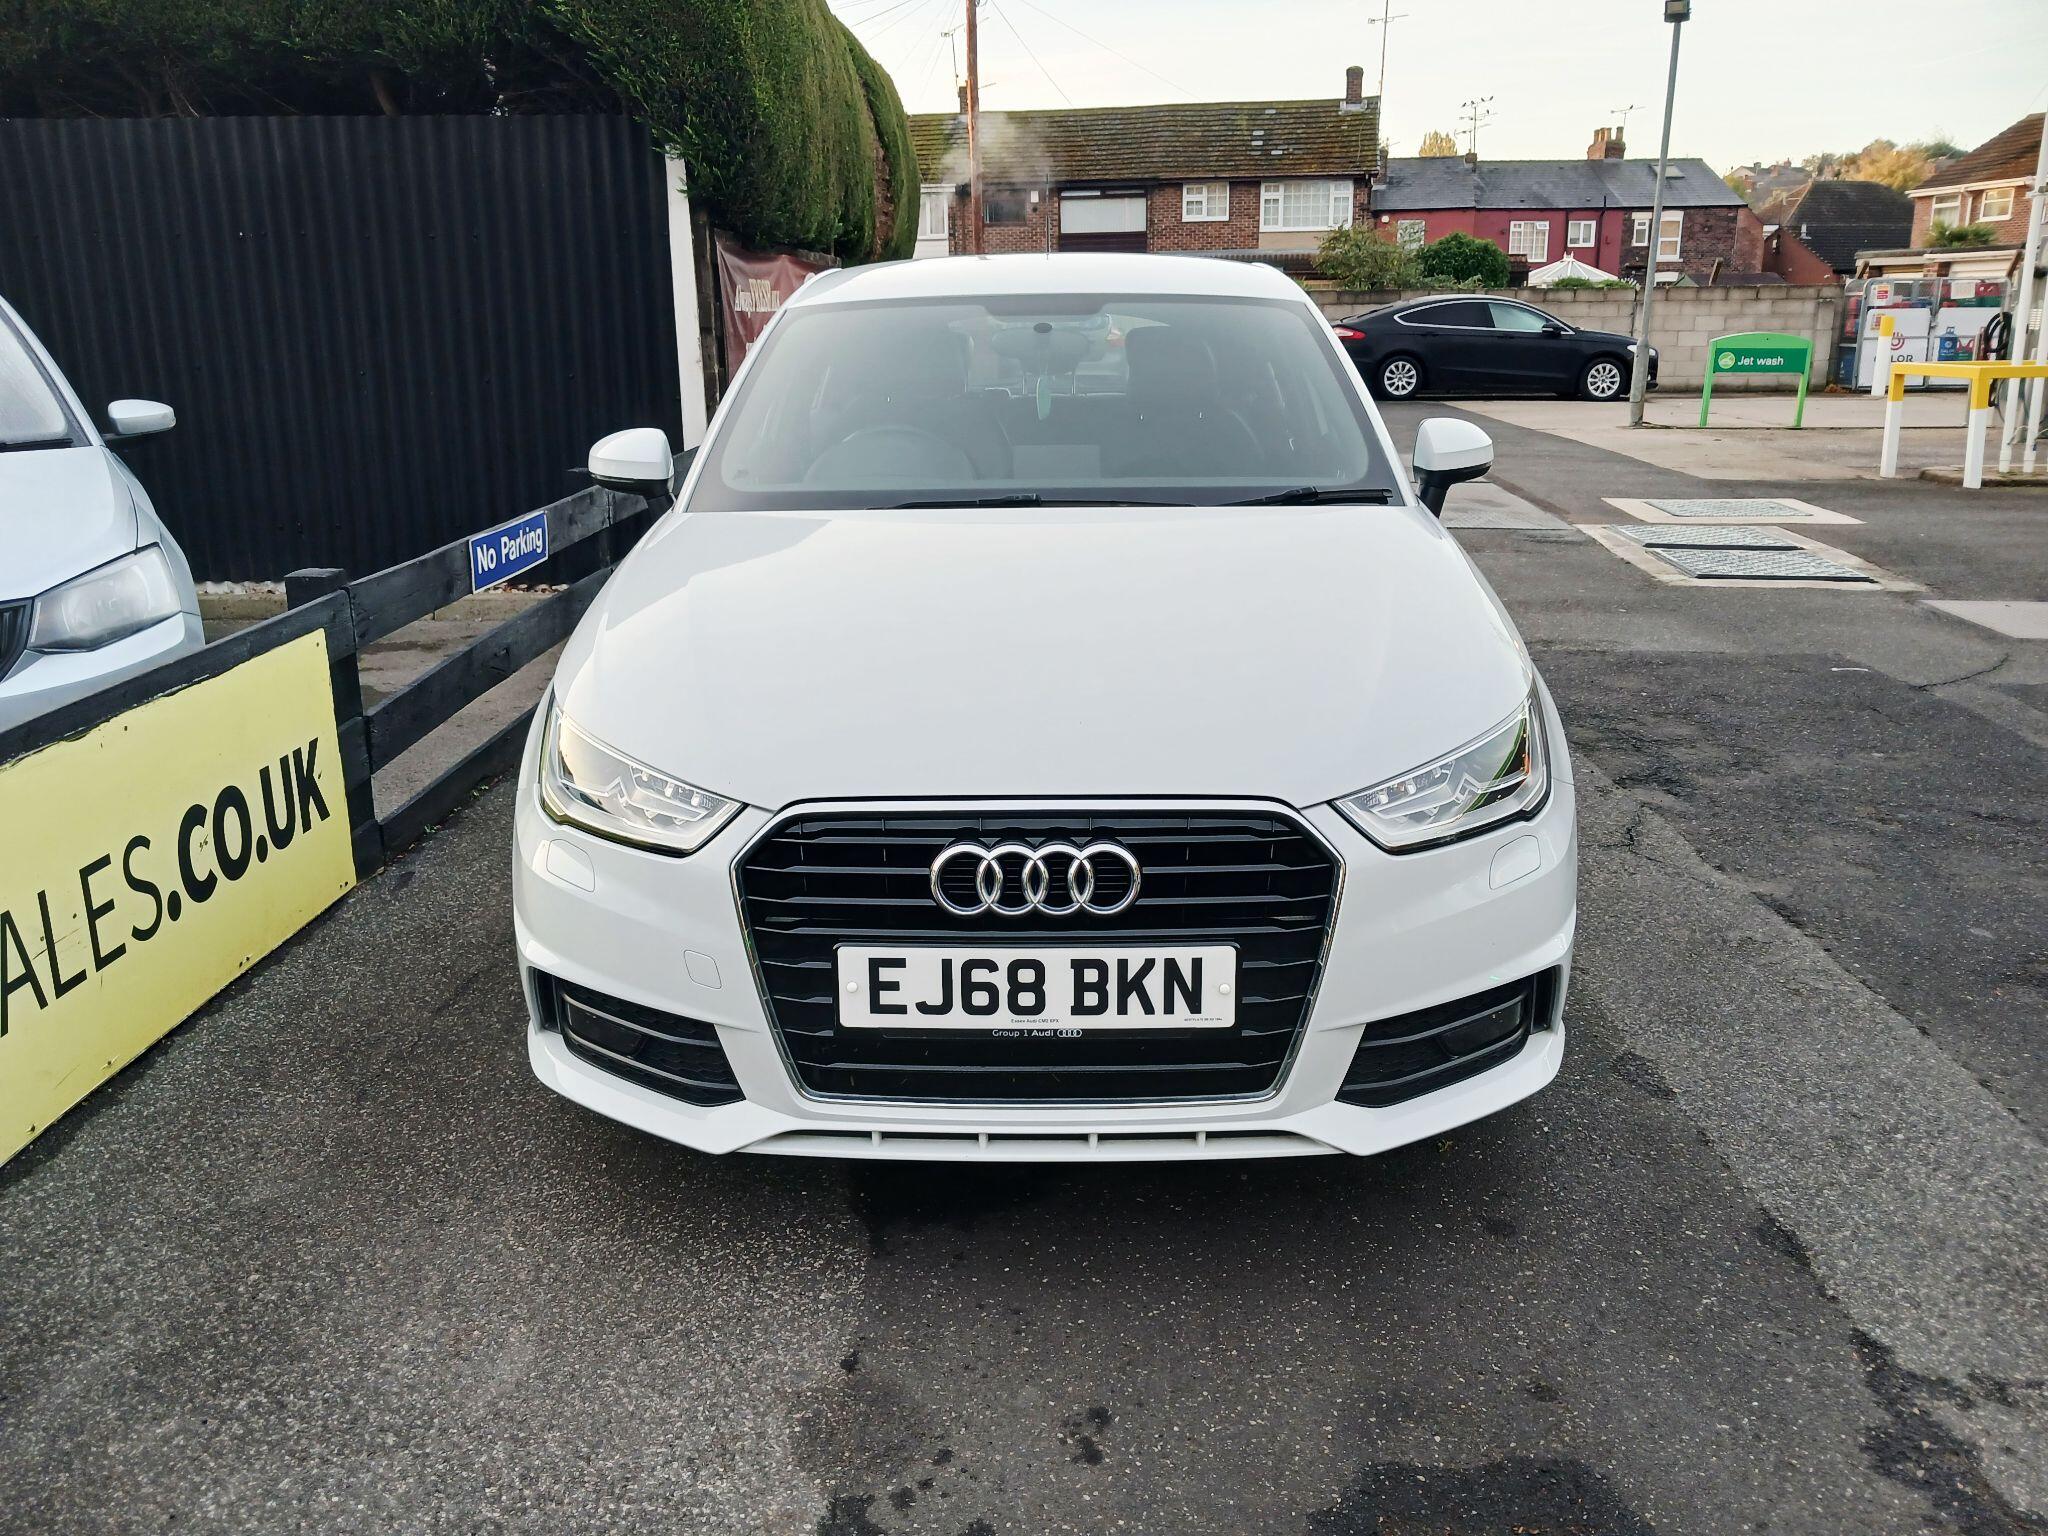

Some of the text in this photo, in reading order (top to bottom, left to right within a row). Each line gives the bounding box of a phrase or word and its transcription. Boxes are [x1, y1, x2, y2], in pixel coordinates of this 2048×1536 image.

[1738, 356, 1784, 366] Jet wash
[476, 527, 543, 575] No Parking
[868, 957, 1203, 1016] EJ68 BKN
[992, 1029, 1054, 1038] Group 1 Audi
